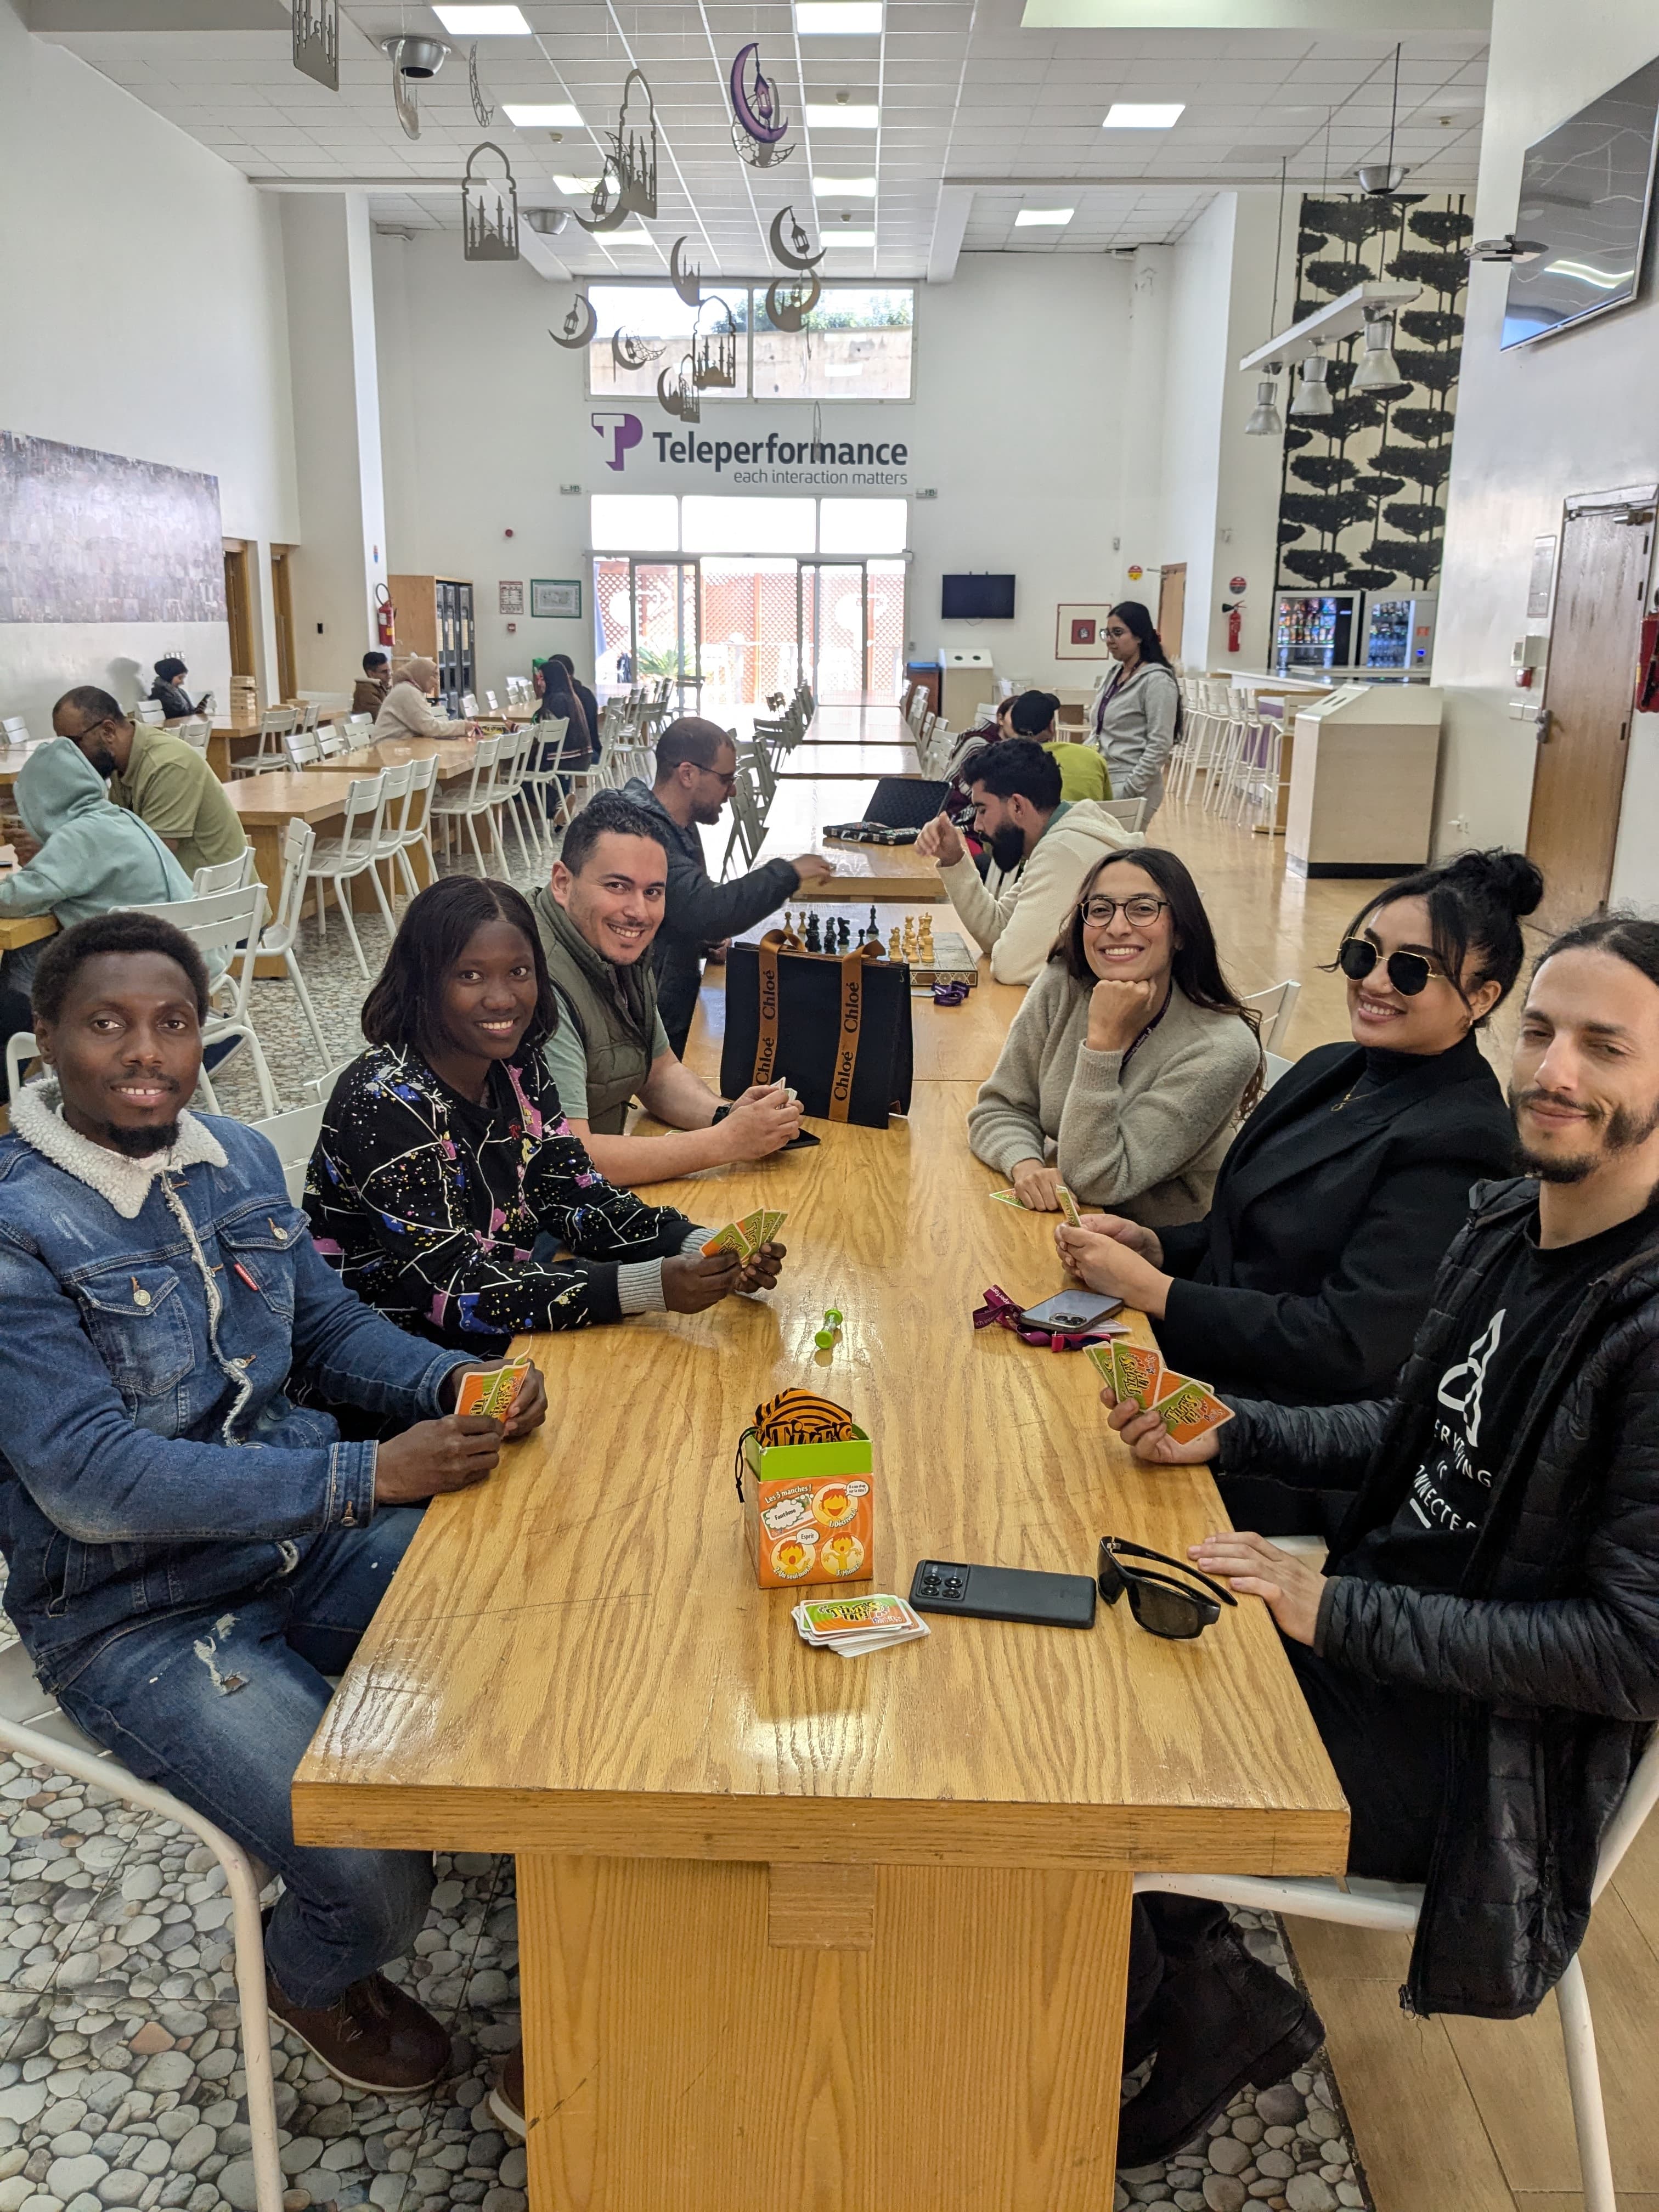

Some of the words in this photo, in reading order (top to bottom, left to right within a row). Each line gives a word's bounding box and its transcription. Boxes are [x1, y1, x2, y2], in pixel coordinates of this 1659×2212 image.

[653, 431, 908, 472] Teleperformance
[733, 469, 768, 483] each
[772, 470, 848, 484] interaction
[853, 472, 908, 485] matters
[763, 969, 776, 1020] Chloé
[844, 981, 859, 1033] Chloé
[755, 1037, 775, 1085] Chloé
[834, 1051, 853, 1101] Chloé
[764, 1494, 776, 1504] Les
[781, 1486, 808, 1498] manches
[774, 1509, 796, 1520] Fantôme
